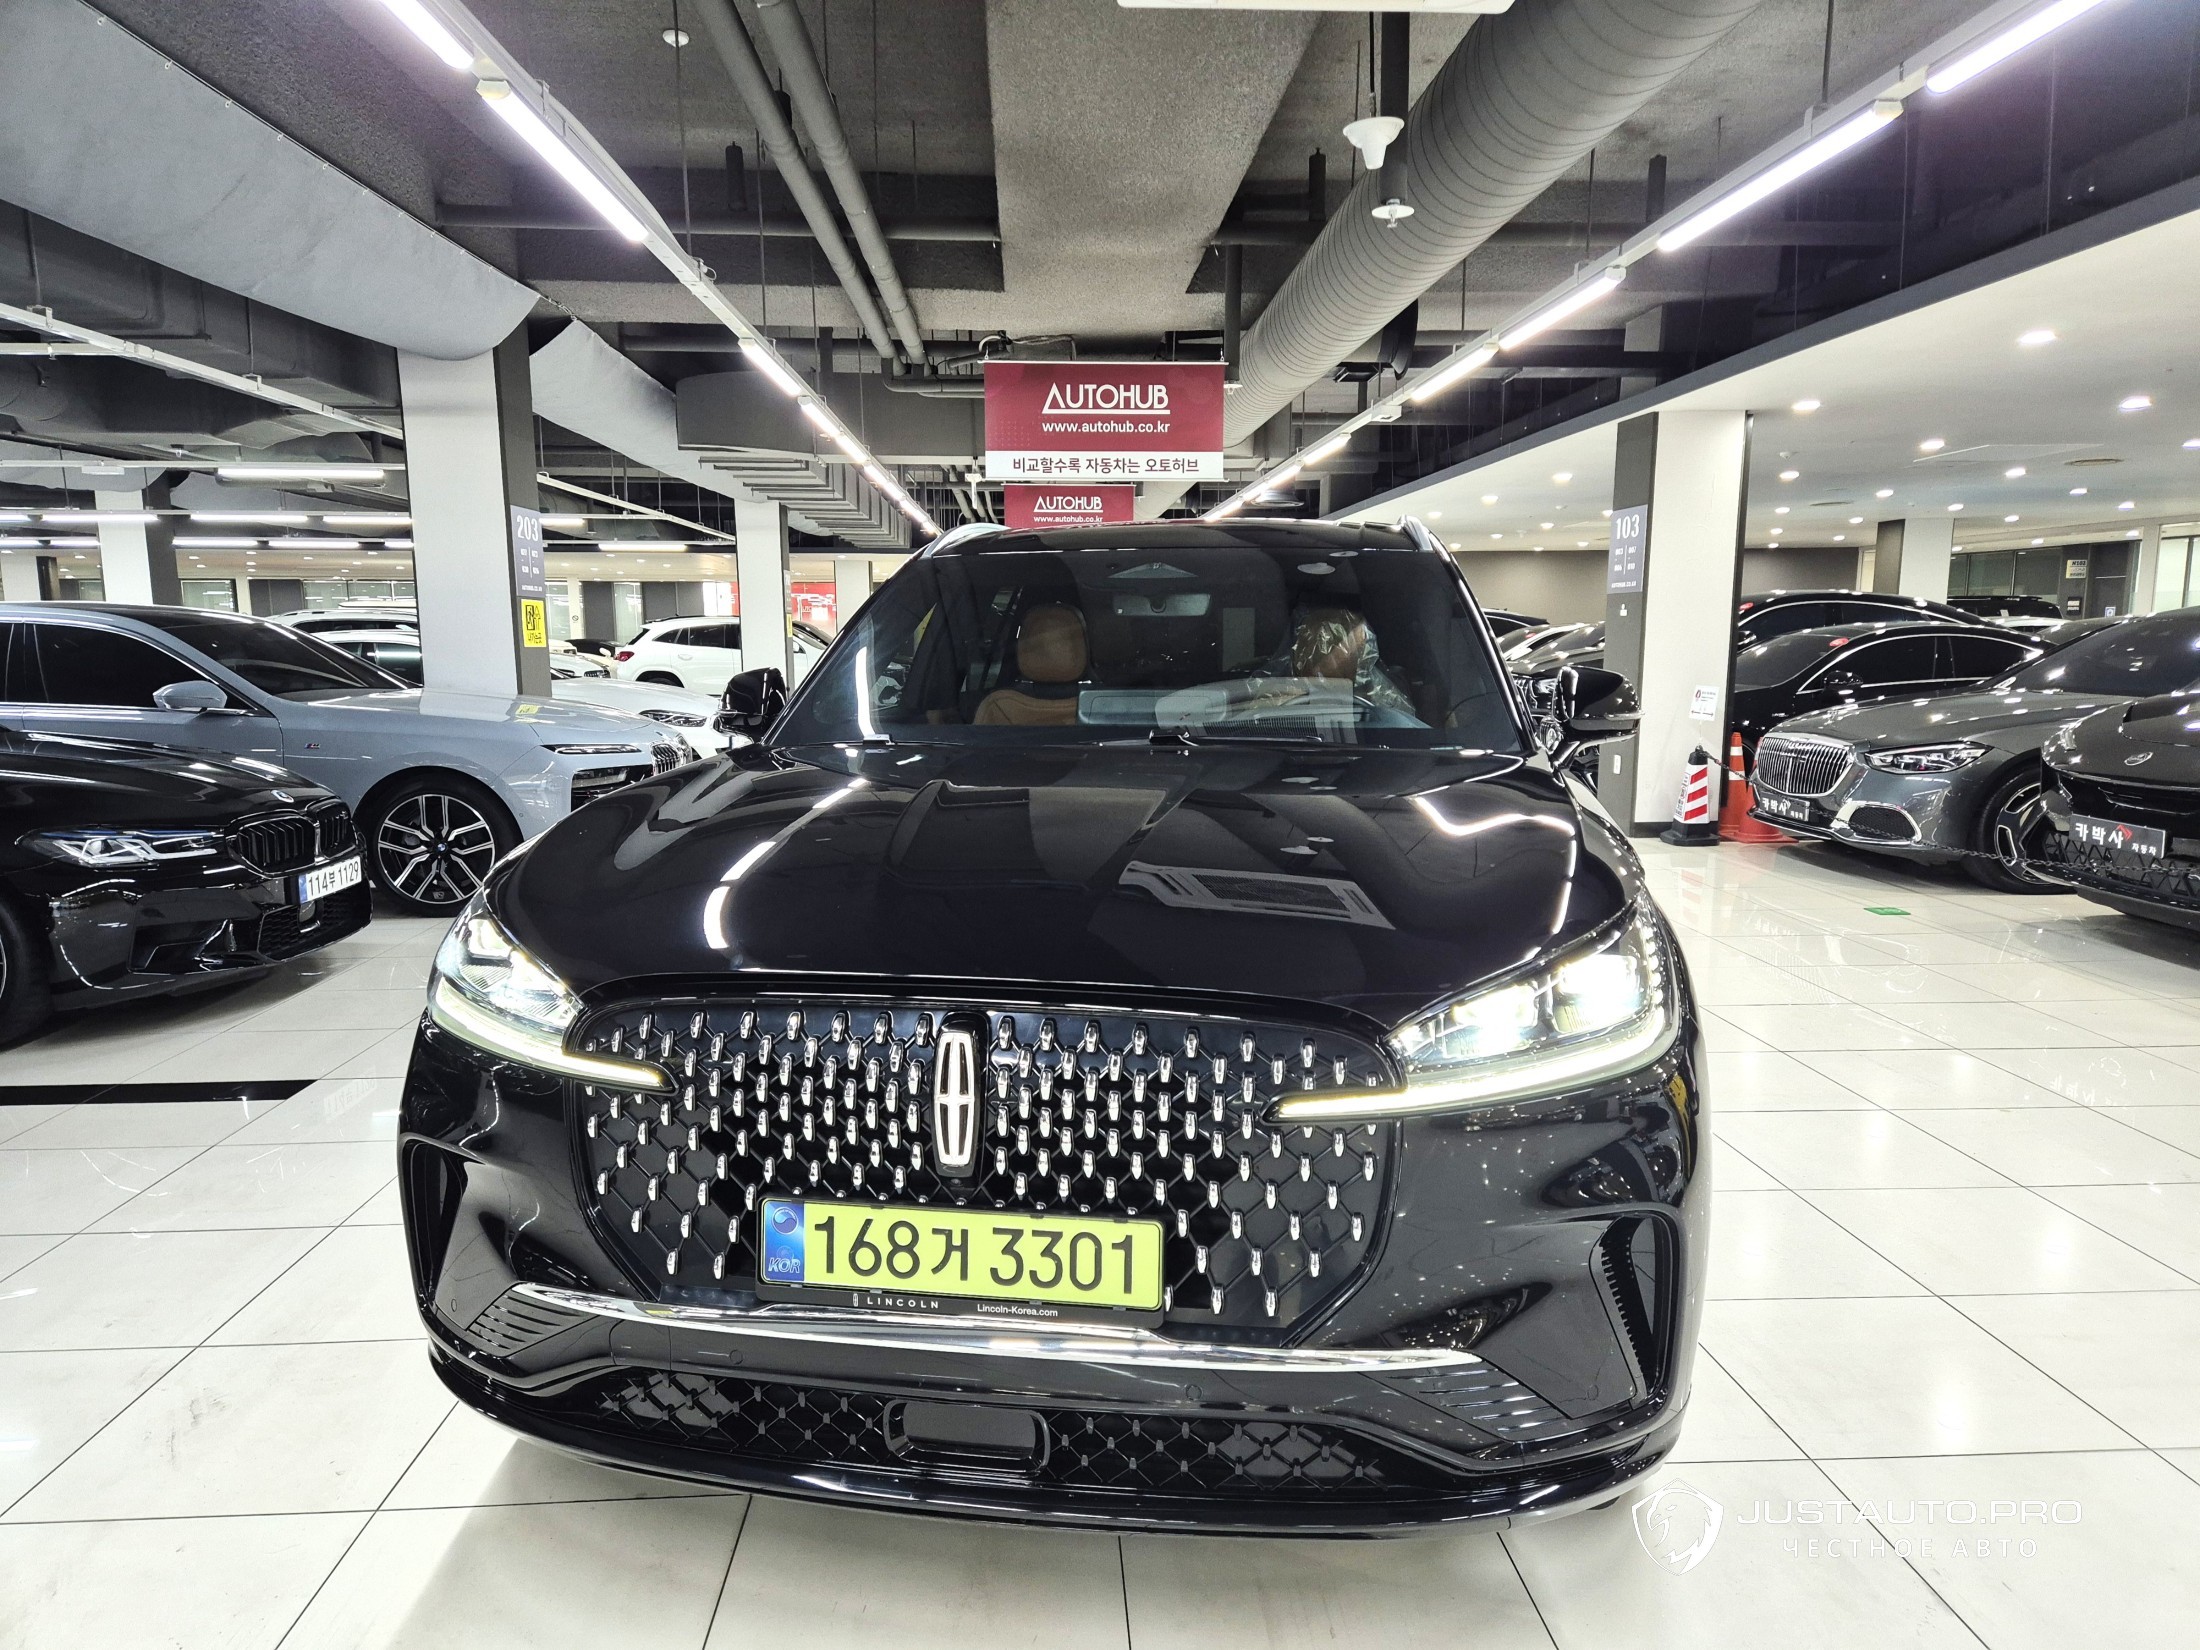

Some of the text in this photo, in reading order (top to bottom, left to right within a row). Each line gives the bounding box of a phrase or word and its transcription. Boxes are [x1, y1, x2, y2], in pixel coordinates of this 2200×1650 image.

[1042, 382, 1170, 414] AUTOHUB
[1042, 420, 1170, 433] www.autohub.co.kr
[1013, 457, 1199, 474] 비교할수록 자동차는 오토허브
[1033, 495, 1103, 512] AUTOHUB
[516, 514, 539, 541] 203
[1616, 514, 1640, 540] 103
[2075, 823, 2123, 849] 카박사
[308, 861, 359, 896] 114부 1129
[768, 1257, 801, 1274] KOR
[814, 1216, 1134, 1294] 168거 3301
[867, 1297, 939, 1309] LINCOLN
[977, 1304, 1058, 1317] Lincoln-Korea.com
